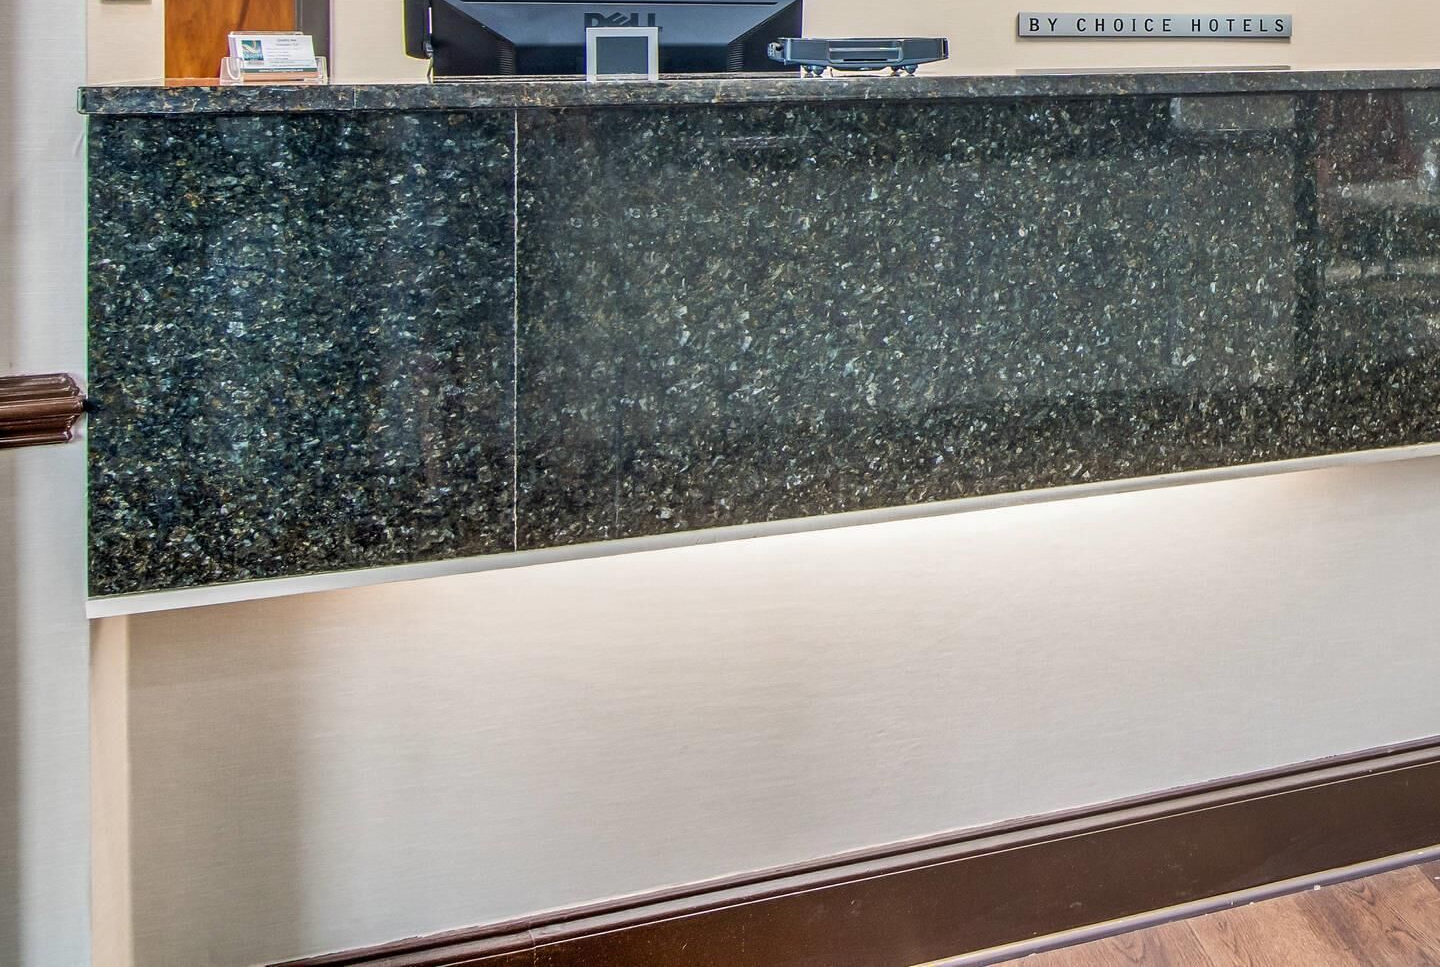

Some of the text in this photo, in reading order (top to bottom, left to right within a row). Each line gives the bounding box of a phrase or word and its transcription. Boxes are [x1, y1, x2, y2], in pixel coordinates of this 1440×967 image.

[1029, 18, 1285, 33] BY CHOICE HOTELS
